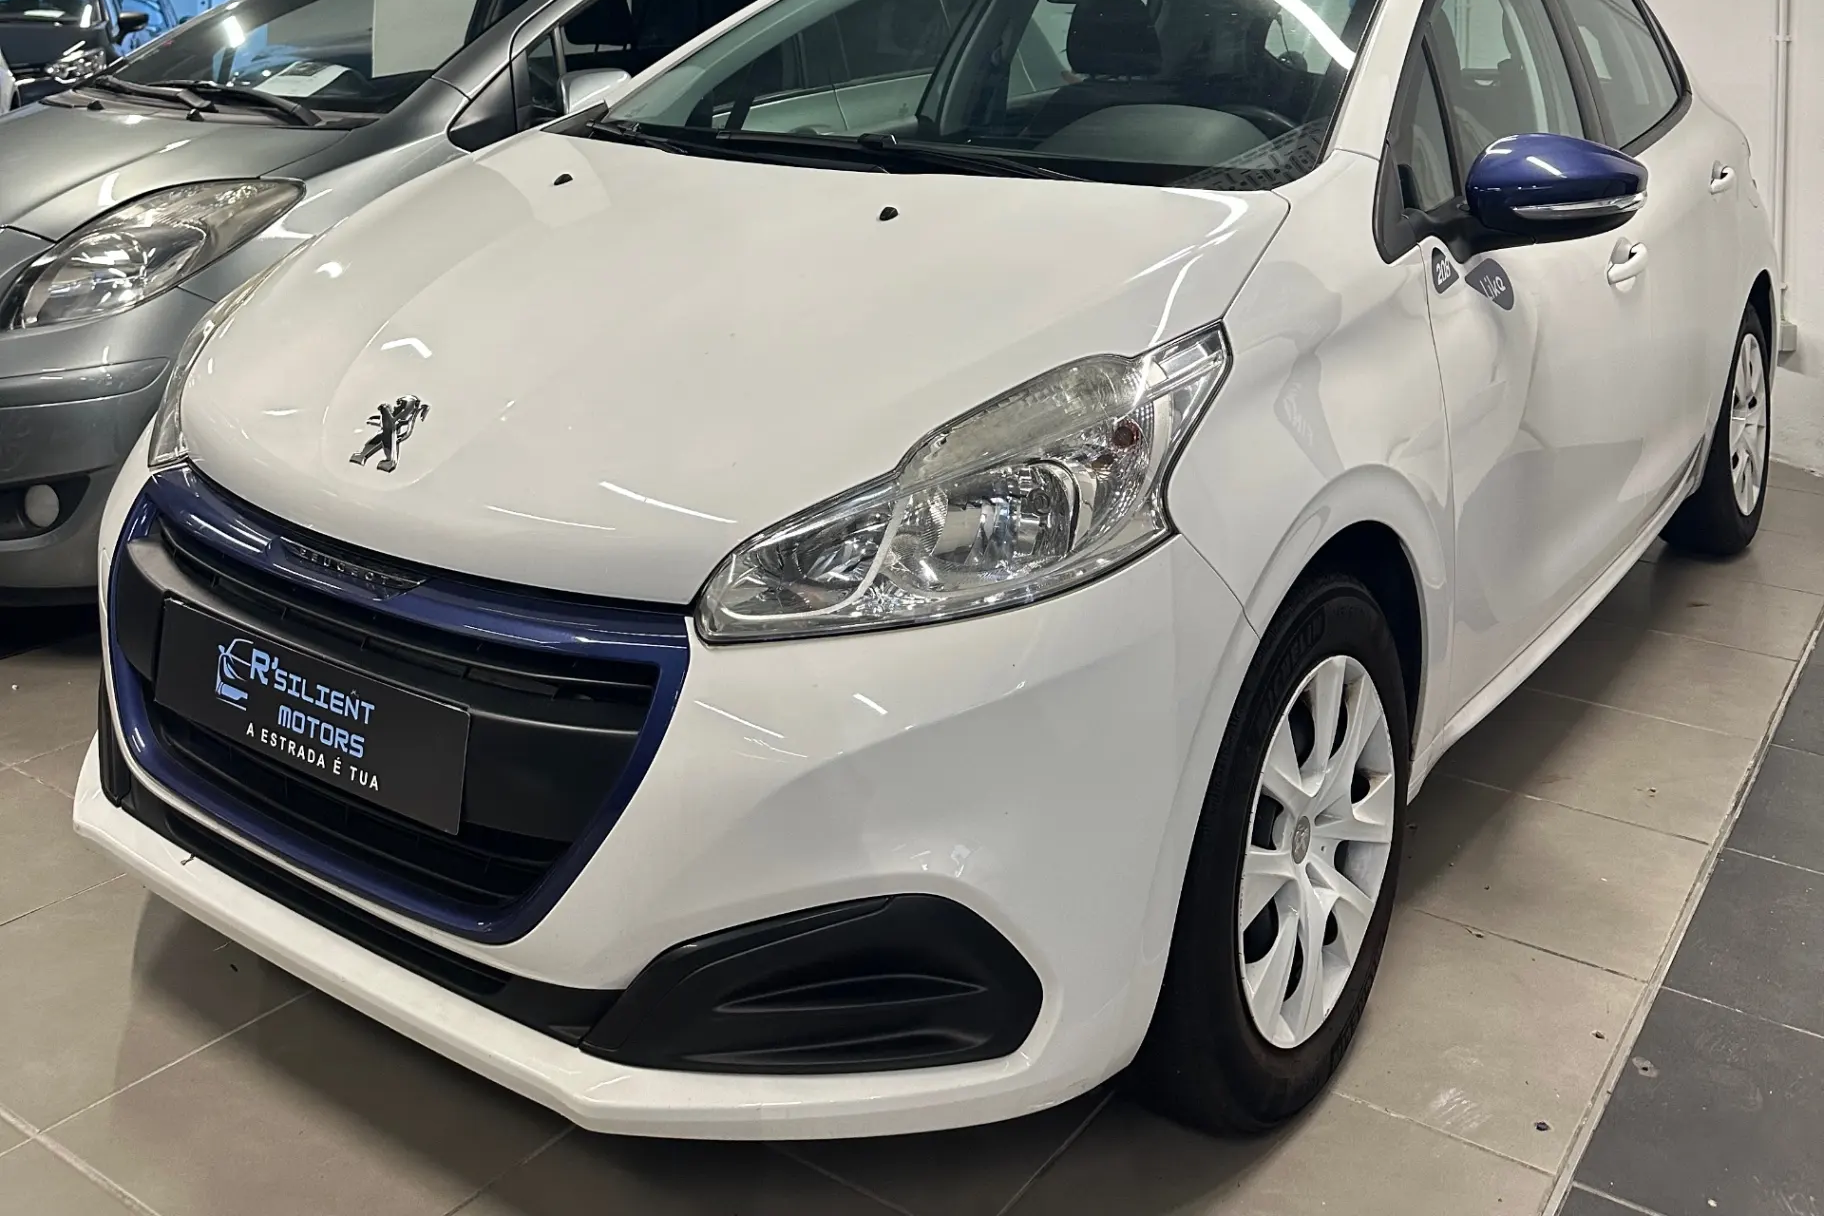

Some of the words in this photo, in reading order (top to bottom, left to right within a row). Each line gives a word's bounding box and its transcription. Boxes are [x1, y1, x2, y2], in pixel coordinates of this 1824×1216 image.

[1480, 275, 1506, 301] Like
[299, 548, 390, 586] PEUGEOT
[277, 705, 365, 759] MOTORS
[246, 723, 255, 737] A
[261, 729, 326, 769] ESTRADA
[333, 756, 341, 775] É
[350, 767, 379, 791] TUA
